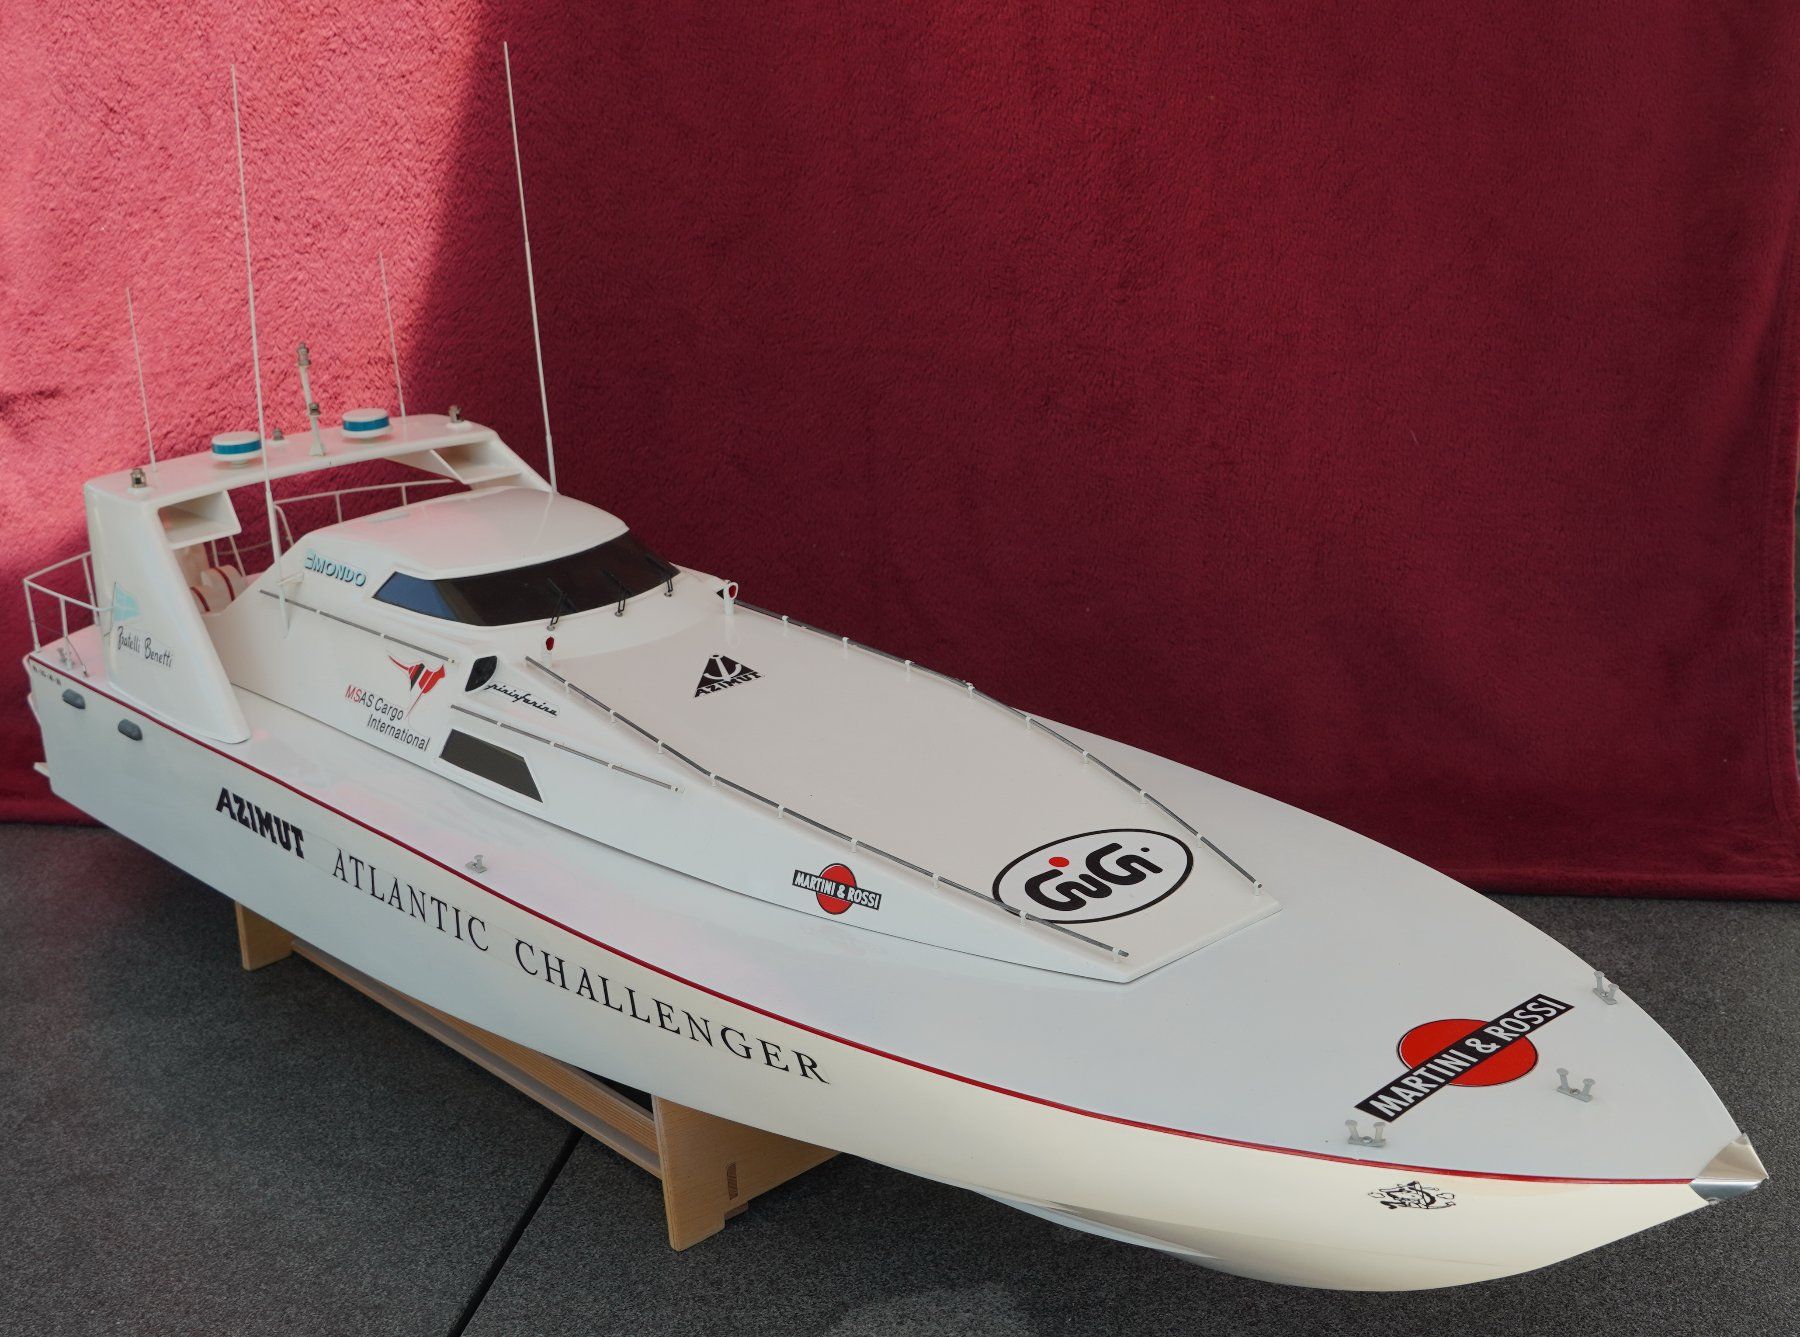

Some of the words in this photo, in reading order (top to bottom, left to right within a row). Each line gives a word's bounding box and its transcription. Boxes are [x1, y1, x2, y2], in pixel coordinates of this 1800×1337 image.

[144, 636, 173, 669] Benetti
[345, 684, 375, 708] MSAS
[374, 697, 404, 722] Cargo
[367, 713, 431, 752] International
[794, 871, 837, 896] MARTINI
[836, 884, 846, 899] &
[846, 887, 880, 909] ROSSI
[215, 786, 305, 859] AZIMUT
[332, 847, 489, 952] ATLANTIC
[514, 937, 832, 1086] CHALLENGER
[1482, 997, 1567, 1042] ROSSI
[1464, 1037, 1501, 1054] &
[1368, 1047, 1479, 1118] MARTINI
